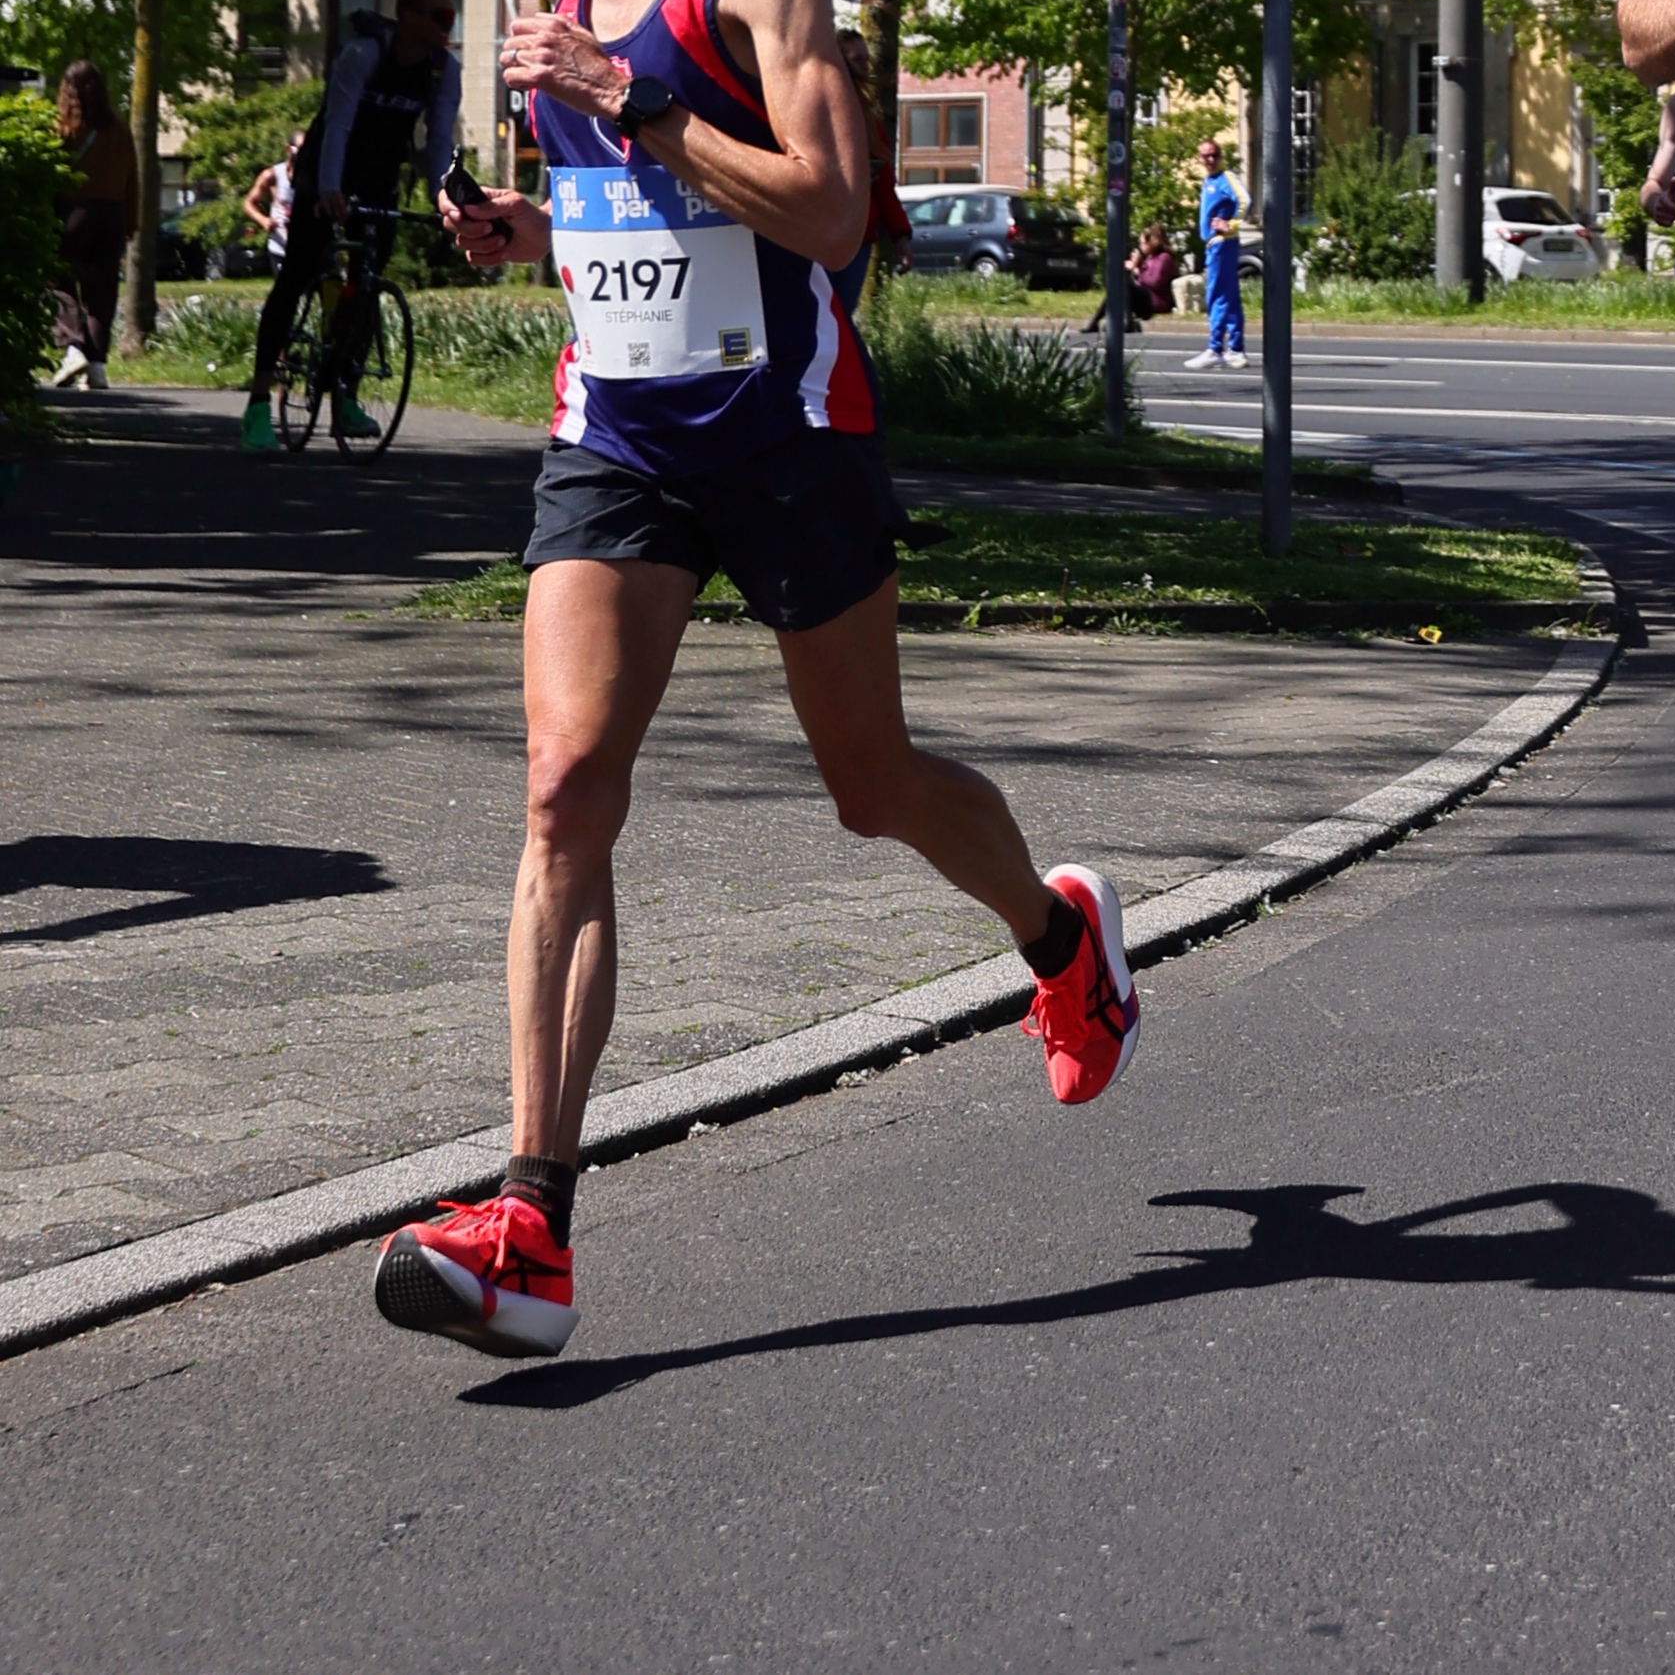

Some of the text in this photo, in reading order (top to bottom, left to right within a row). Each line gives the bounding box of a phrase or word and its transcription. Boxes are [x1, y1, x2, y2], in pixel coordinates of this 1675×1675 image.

[557, 175, 578, 200] uni
[603, 174, 641, 201] uni
[562, 198, 587, 224] per
[612, 198, 655, 225] per
[685, 197, 719, 221] pe
[587, 256, 692, 302] 2197
[605, 307, 674, 323] STÉPHANIE
